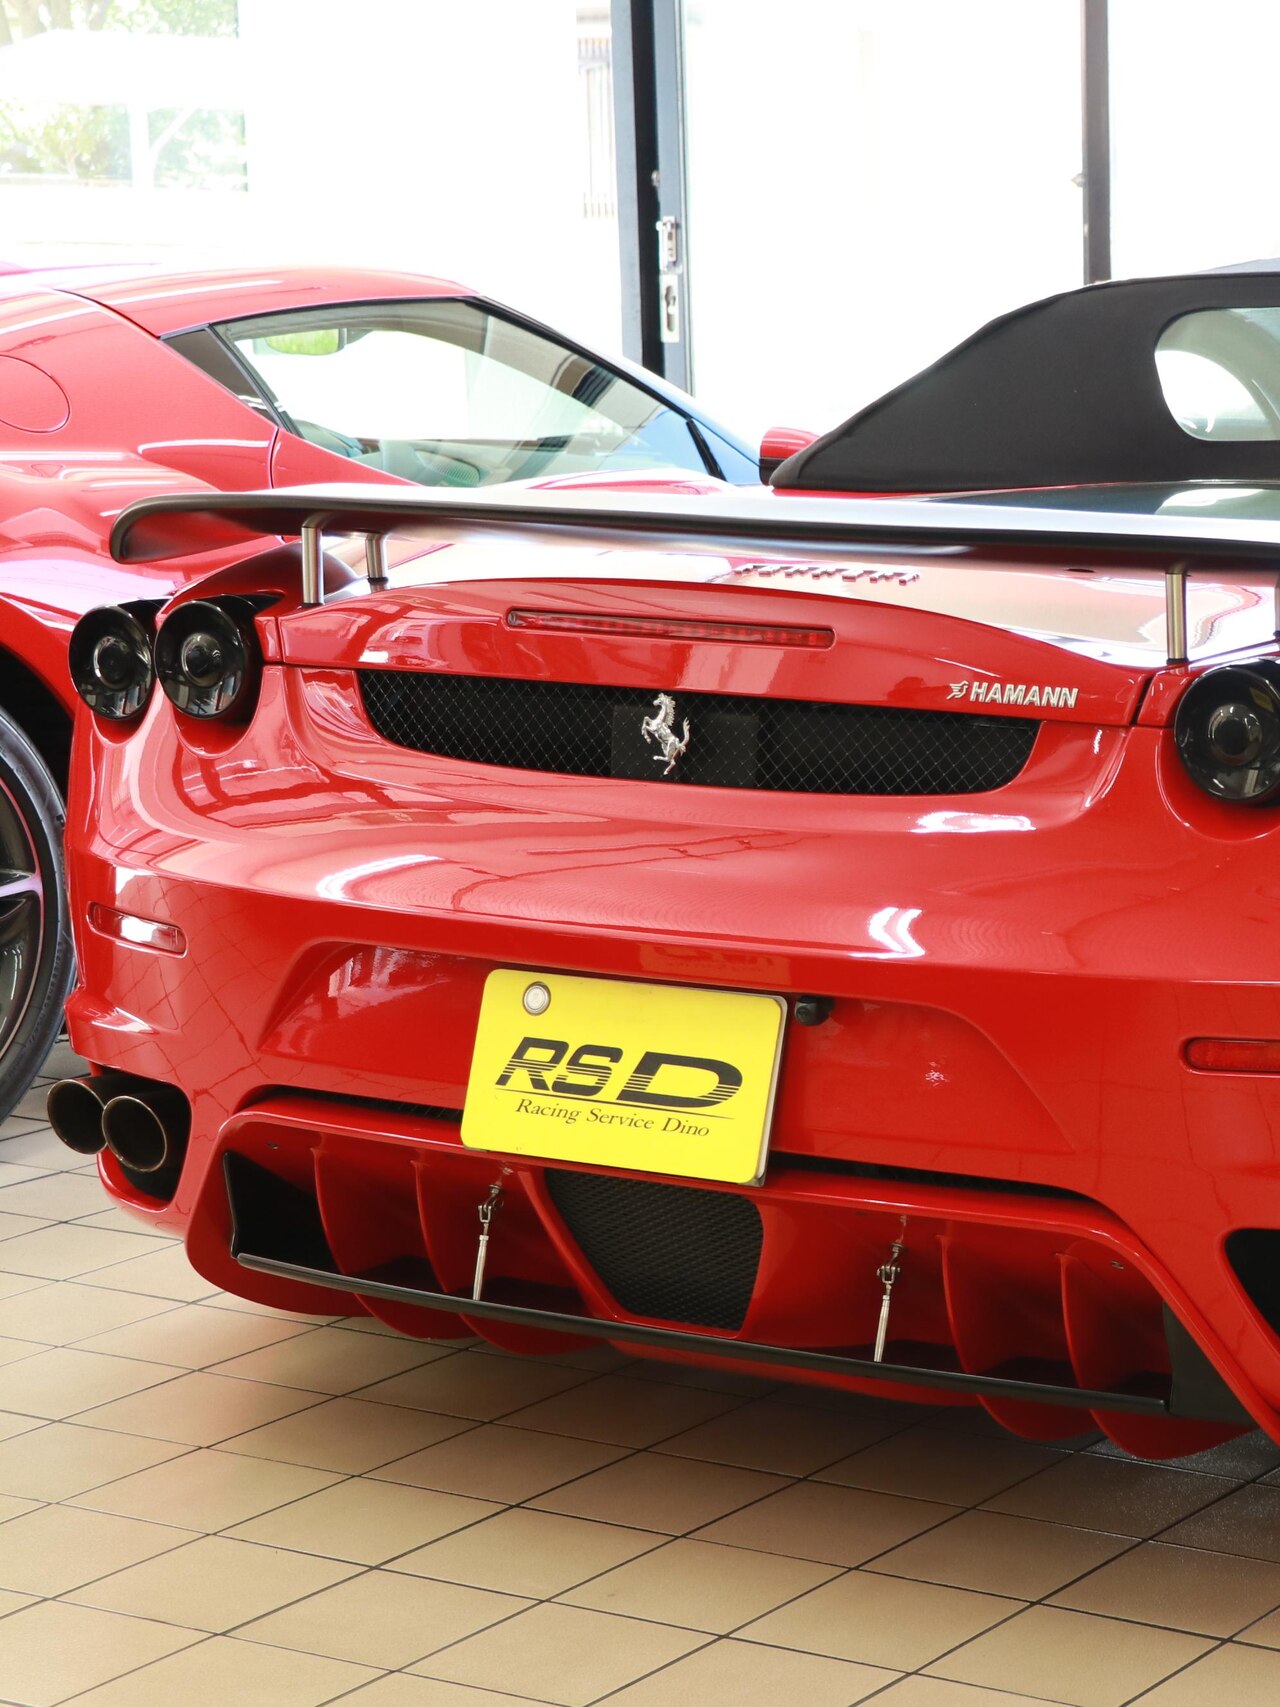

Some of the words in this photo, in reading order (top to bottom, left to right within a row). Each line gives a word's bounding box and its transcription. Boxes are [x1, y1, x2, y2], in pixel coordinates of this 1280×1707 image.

[969, 681, 1079, 709] HAMANN
[494, 1036, 744, 1109] RSD
[515, 1098, 581, 1125] Racing
[586, 1107, 655, 1130] Service
[661, 1117, 710, 1137] Dino
